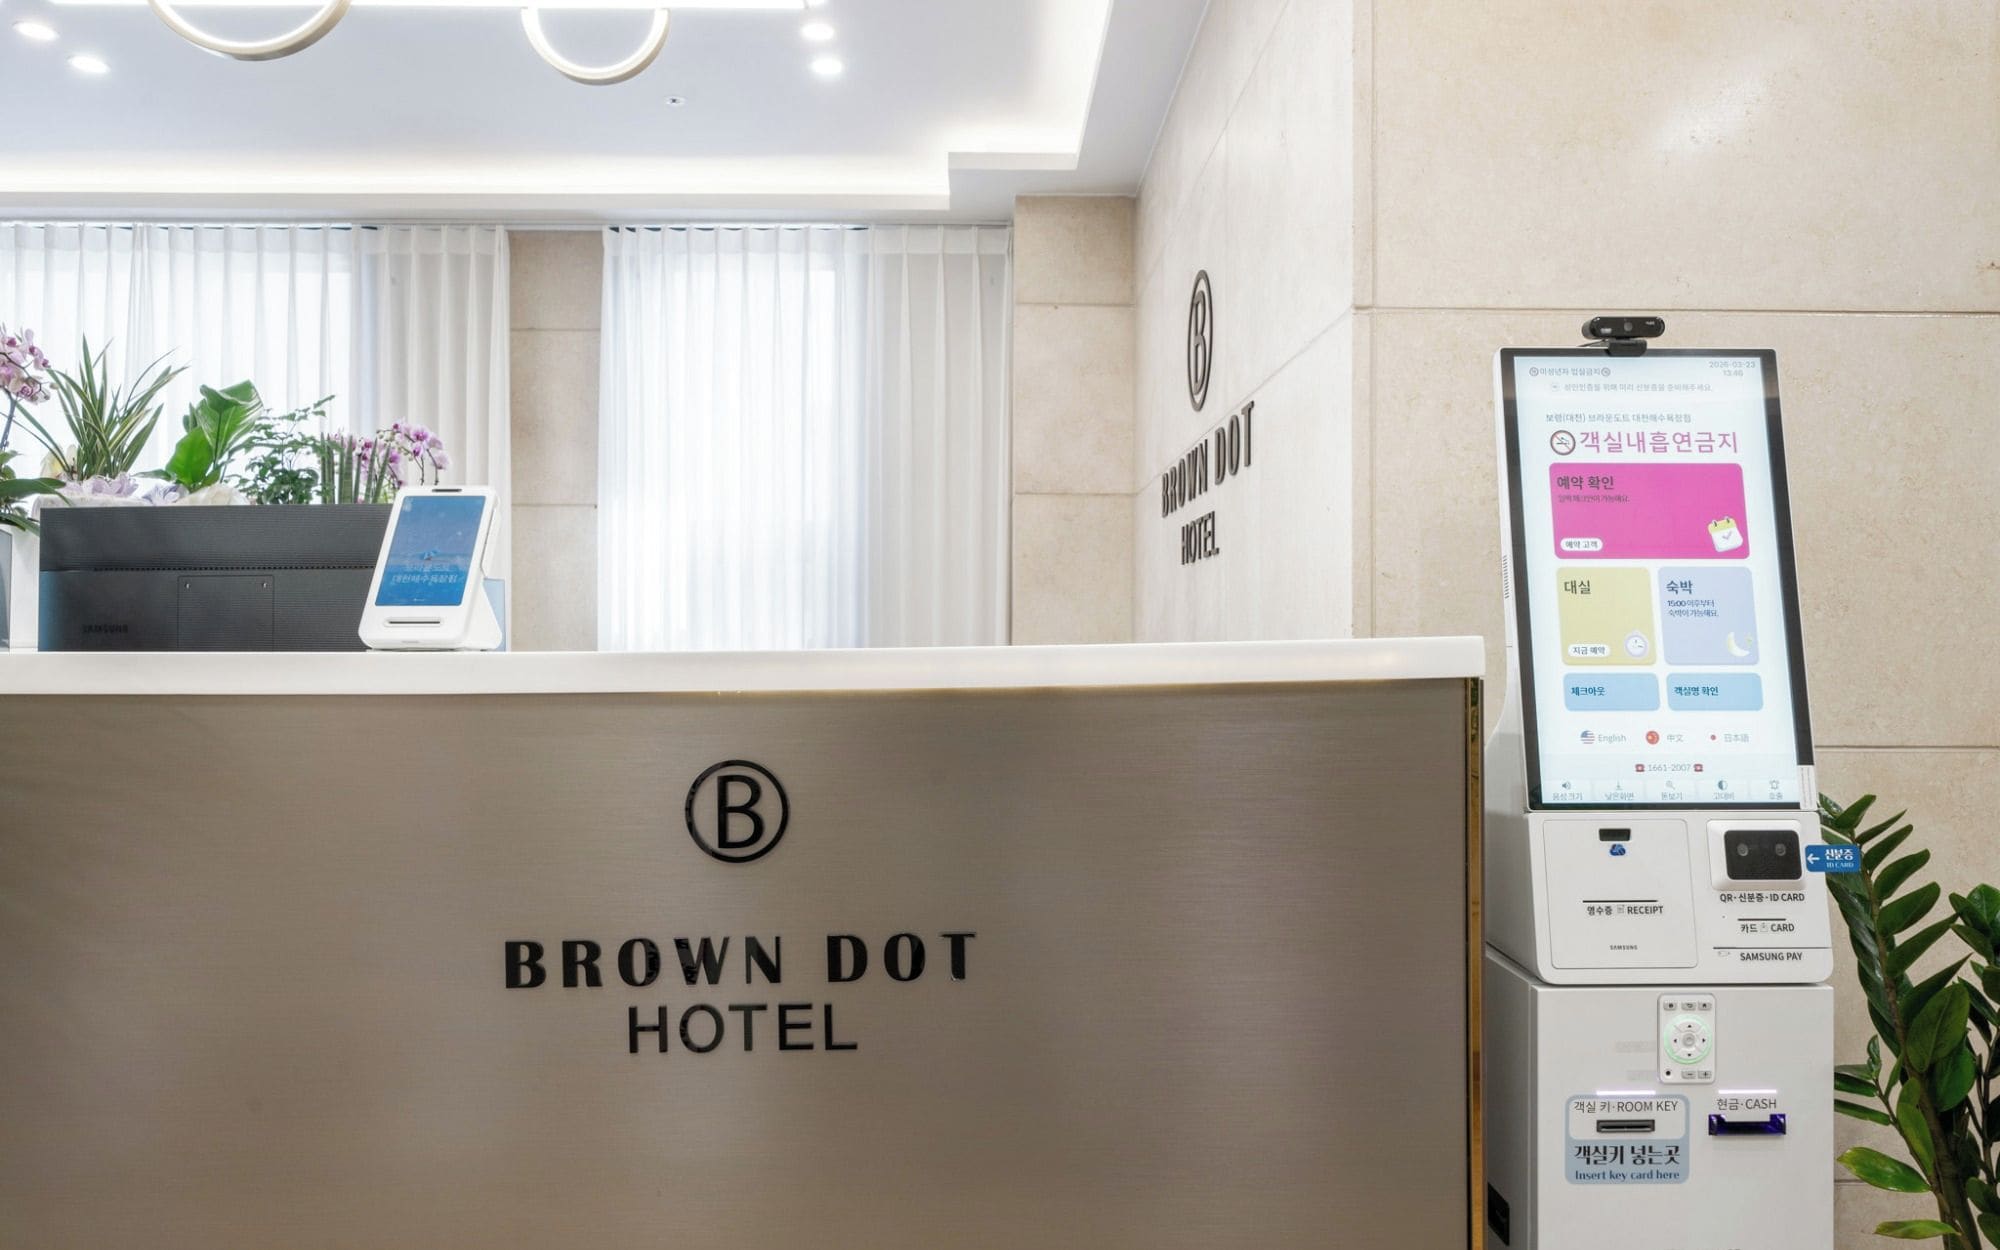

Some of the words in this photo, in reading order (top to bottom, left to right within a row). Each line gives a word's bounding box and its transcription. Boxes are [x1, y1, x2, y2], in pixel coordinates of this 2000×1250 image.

[1580, 431, 1738, 454] 객실내흡연금지
[1162, 438, 1208, 518] BROWN
[1214, 400, 1255, 486] DOT
[1557, 475, 1583, 490] 예약
[1588, 475, 1614, 490] 확인
[1181, 510, 1220, 565] HOTEL
[1565, 540, 1580, 549] 예약
[1582, 540, 1598, 549] 고객
[1564, 580, 1591, 595] 대실
[1666, 580, 1693, 595] 숙박
[1573, 646, 1588, 655] 지금
[1590, 646, 1605, 655] 예약
[1571, 686, 1605, 697] 체크아웃
[1701, 686, 1718, 697] 확인
[1598, 734, 1626, 743] English
[1667, 734, 1683, 743] 中文
[1648, 763, 1691, 772] 1661-2007
[1825, 848, 1854, 861] 신분증
[1781, 893, 1805, 902] CARD
[1587, 905, 1612, 915] 영수증
[1627, 905, 1664, 915] RECEIPT
[1741, 923, 1758, 934] 카드
[1770, 923, 1795, 932] CARD
[504, 935, 782, 989] BROWN
[826, 931, 977, 983] DOT
[1740, 952, 1784, 961] SAMSUNG
[1787, 952, 1803, 961] PAY
[627, 1002, 858, 1054] HOTEL
[1574, 1101, 1596, 1113] 객실
[1656, 1100, 1678, 1111] KEY
[1575, 1145, 1624, 1165] 객실키
[1631, 1145, 1680, 1165] 넣는곳
[1575, 1170, 1606, 1180] Insert
[1609, 1170, 1626, 1182] key
[1630, 1170, 1653, 1180] card
[1656, 1170, 1680, 1180] here
